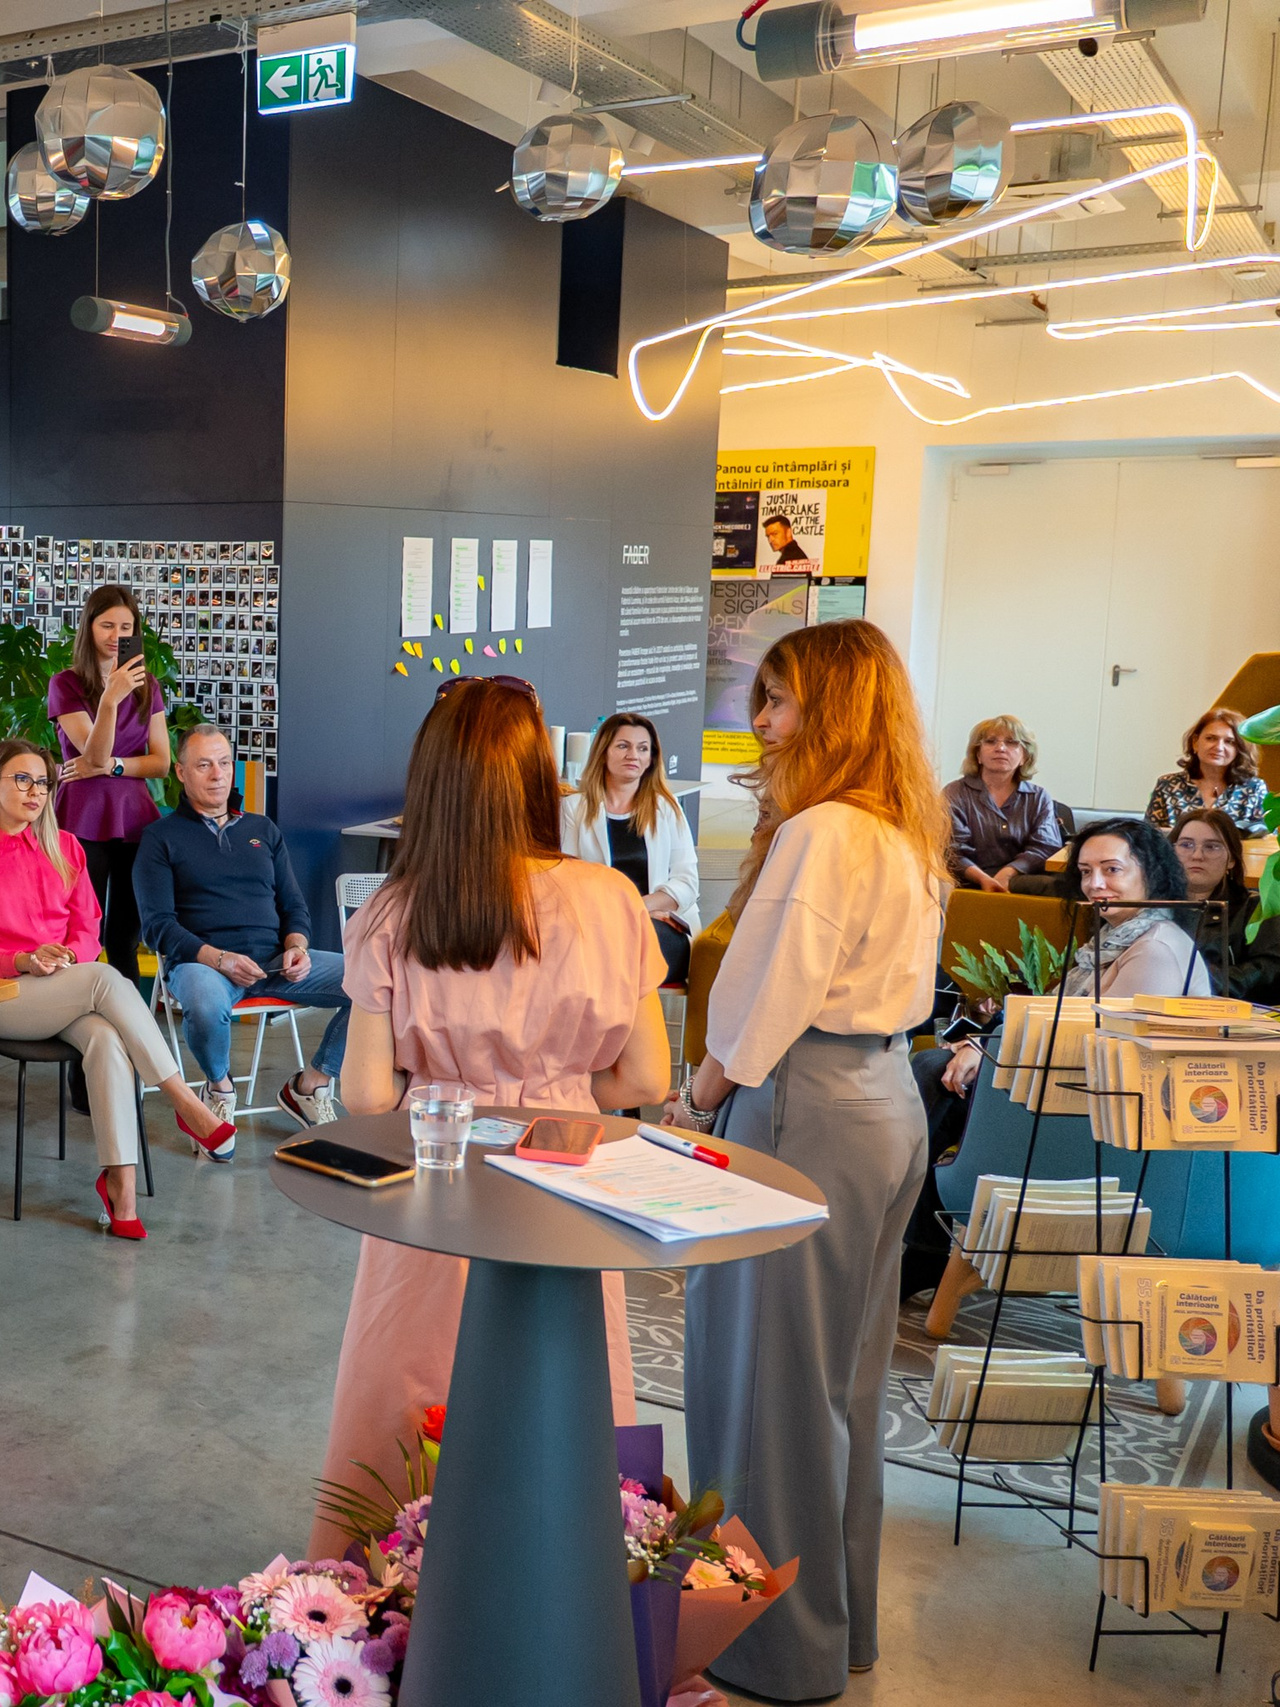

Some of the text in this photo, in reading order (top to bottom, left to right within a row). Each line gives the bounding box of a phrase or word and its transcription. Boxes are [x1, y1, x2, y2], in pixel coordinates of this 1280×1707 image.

[716, 460, 851, 475] Panou cu întâmplări și
[766, 478, 784, 489] din
[766, 493, 798, 506] JUSTIN
[761, 503, 820, 516] TIMBERLAKE
[792, 516, 820, 526] AT THE
[793, 524, 824, 535] CASTLE
[622, 545, 650, 565] FABER
[1187, 1062, 1226, 1070] Călătorii
[1245, 1065, 1258, 1131] priorităților!
[1257, 1061, 1268, 1135] Dă prioritate,
[1137, 1278, 1152, 1298] 55
[1179, 1293, 1217, 1302] Călătorii
[1176, 1300, 1219, 1309] interioare
[1244, 1293, 1256, 1360] priorităților!
[1254, 1290, 1265, 1364] Dă prioritate,
